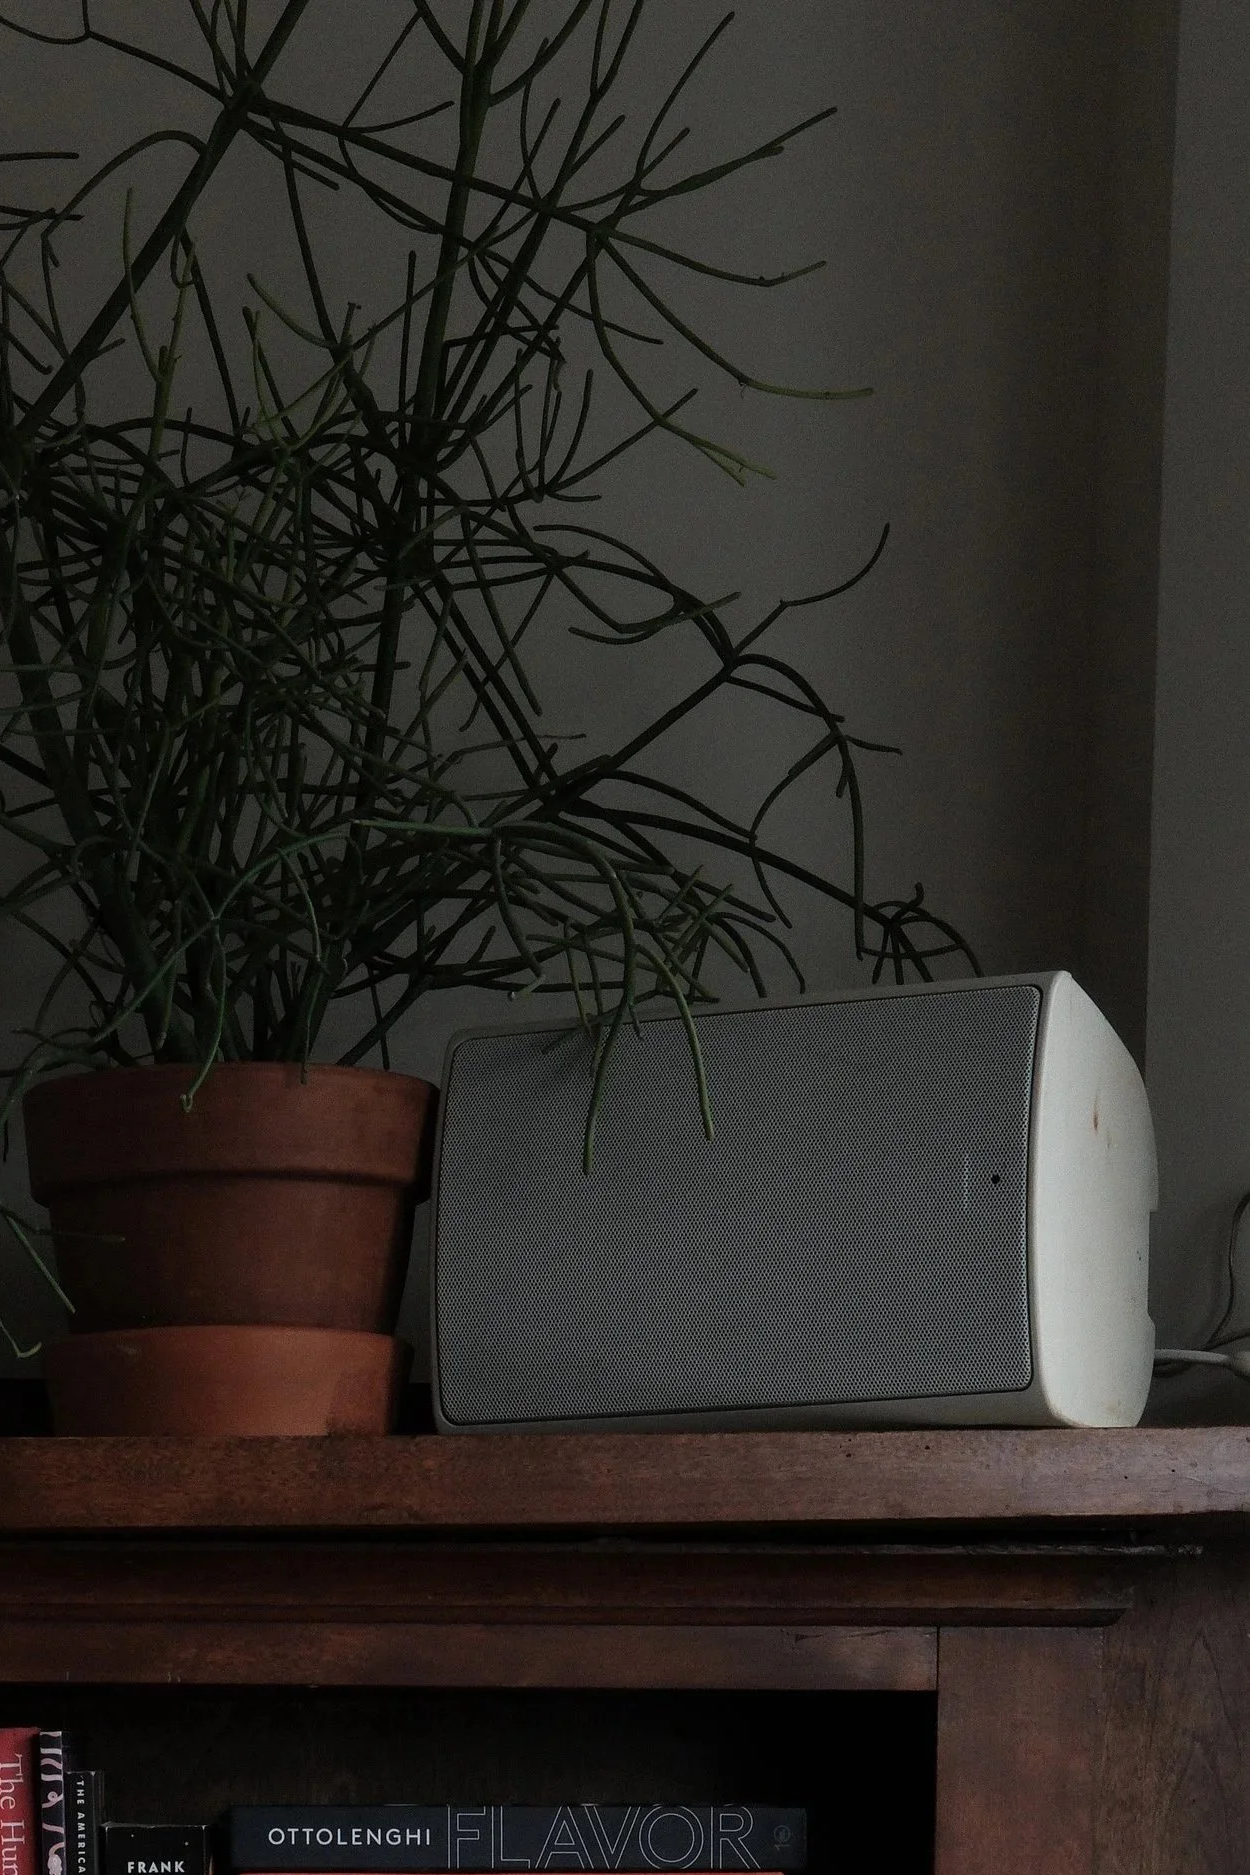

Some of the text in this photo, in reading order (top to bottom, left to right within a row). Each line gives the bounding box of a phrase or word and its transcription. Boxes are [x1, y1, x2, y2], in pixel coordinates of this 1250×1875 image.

[268, 1828, 430, 1846] OTTOLENGHI
[449, 1806, 760, 1869] FLAVOR
[127, 1861, 186, 1873] FRANK
